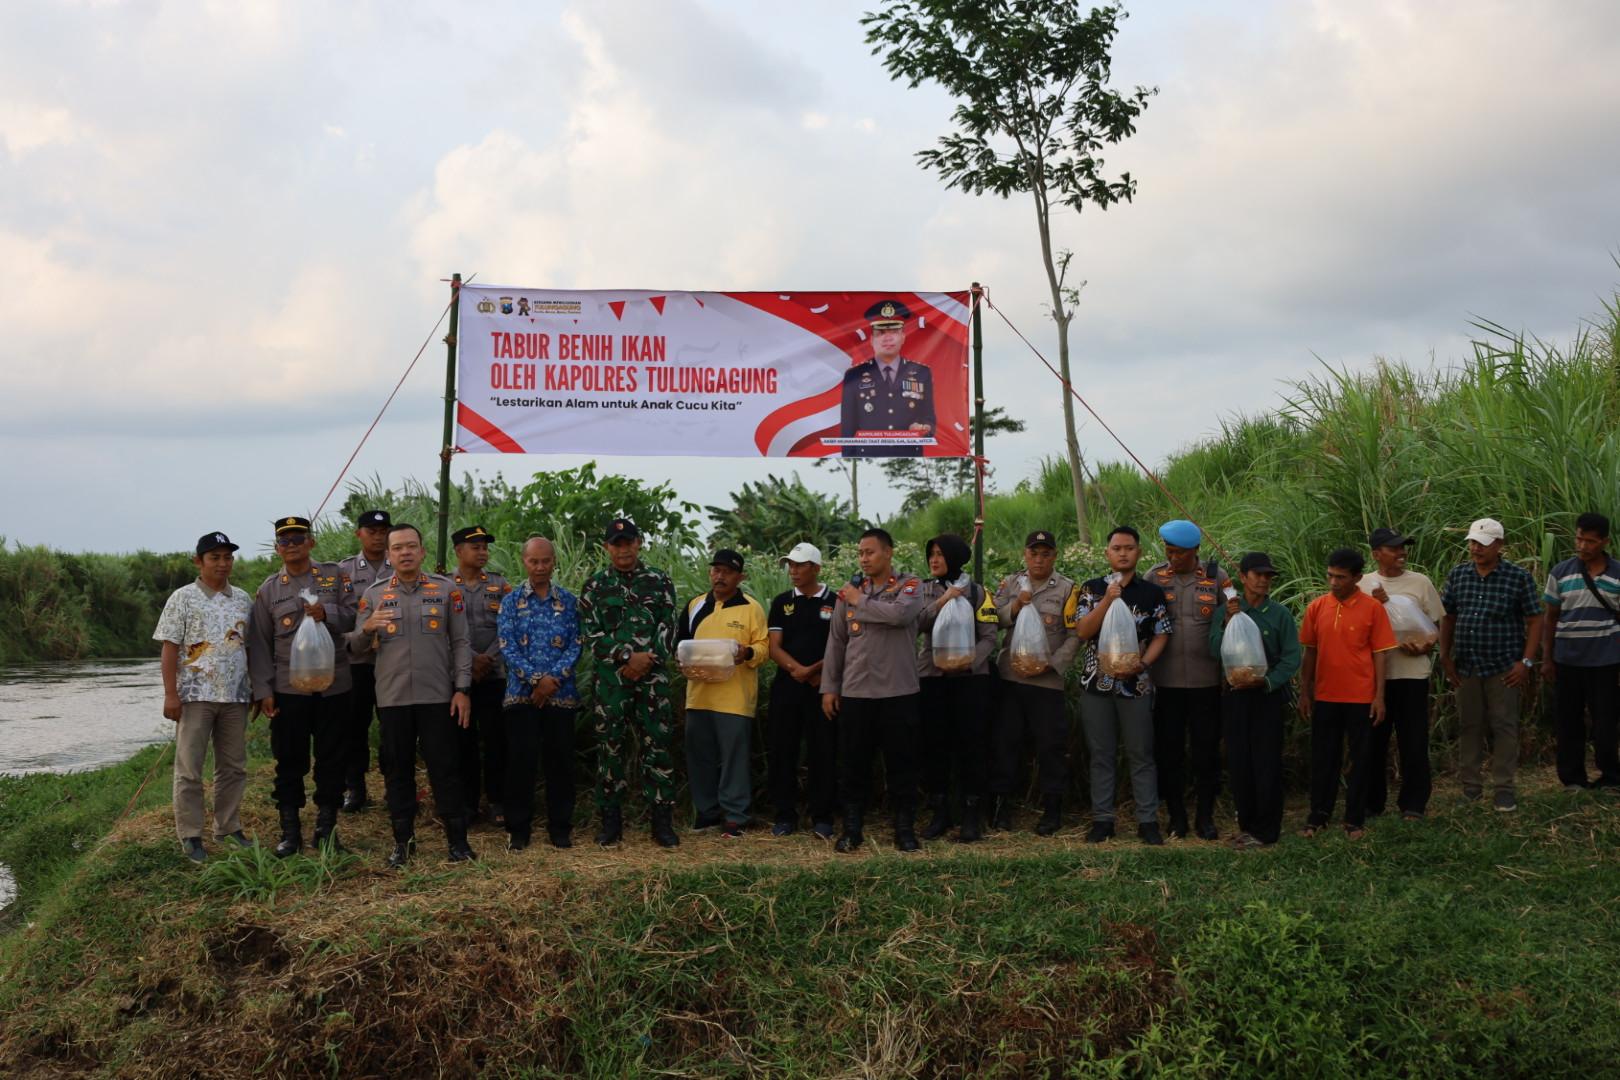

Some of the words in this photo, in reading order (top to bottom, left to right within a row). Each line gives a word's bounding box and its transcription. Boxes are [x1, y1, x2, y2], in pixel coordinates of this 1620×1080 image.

[490, 332, 550, 360] TABUR
[558, 334, 614, 361] BENIH
[622, 335, 667, 362] IKAN
[490, 363, 536, 390] OLEH
[544, 365, 638, 392] KAPOLRES
[646, 367, 778, 394] TULUNGAGUNG
[565, 398, 599, 410] Alam
[602, 399, 638, 410] untuk
[641, 399, 673, 410] Anak
[675, 400, 708, 411] Cucu
[711, 400, 742, 411] Kita”
